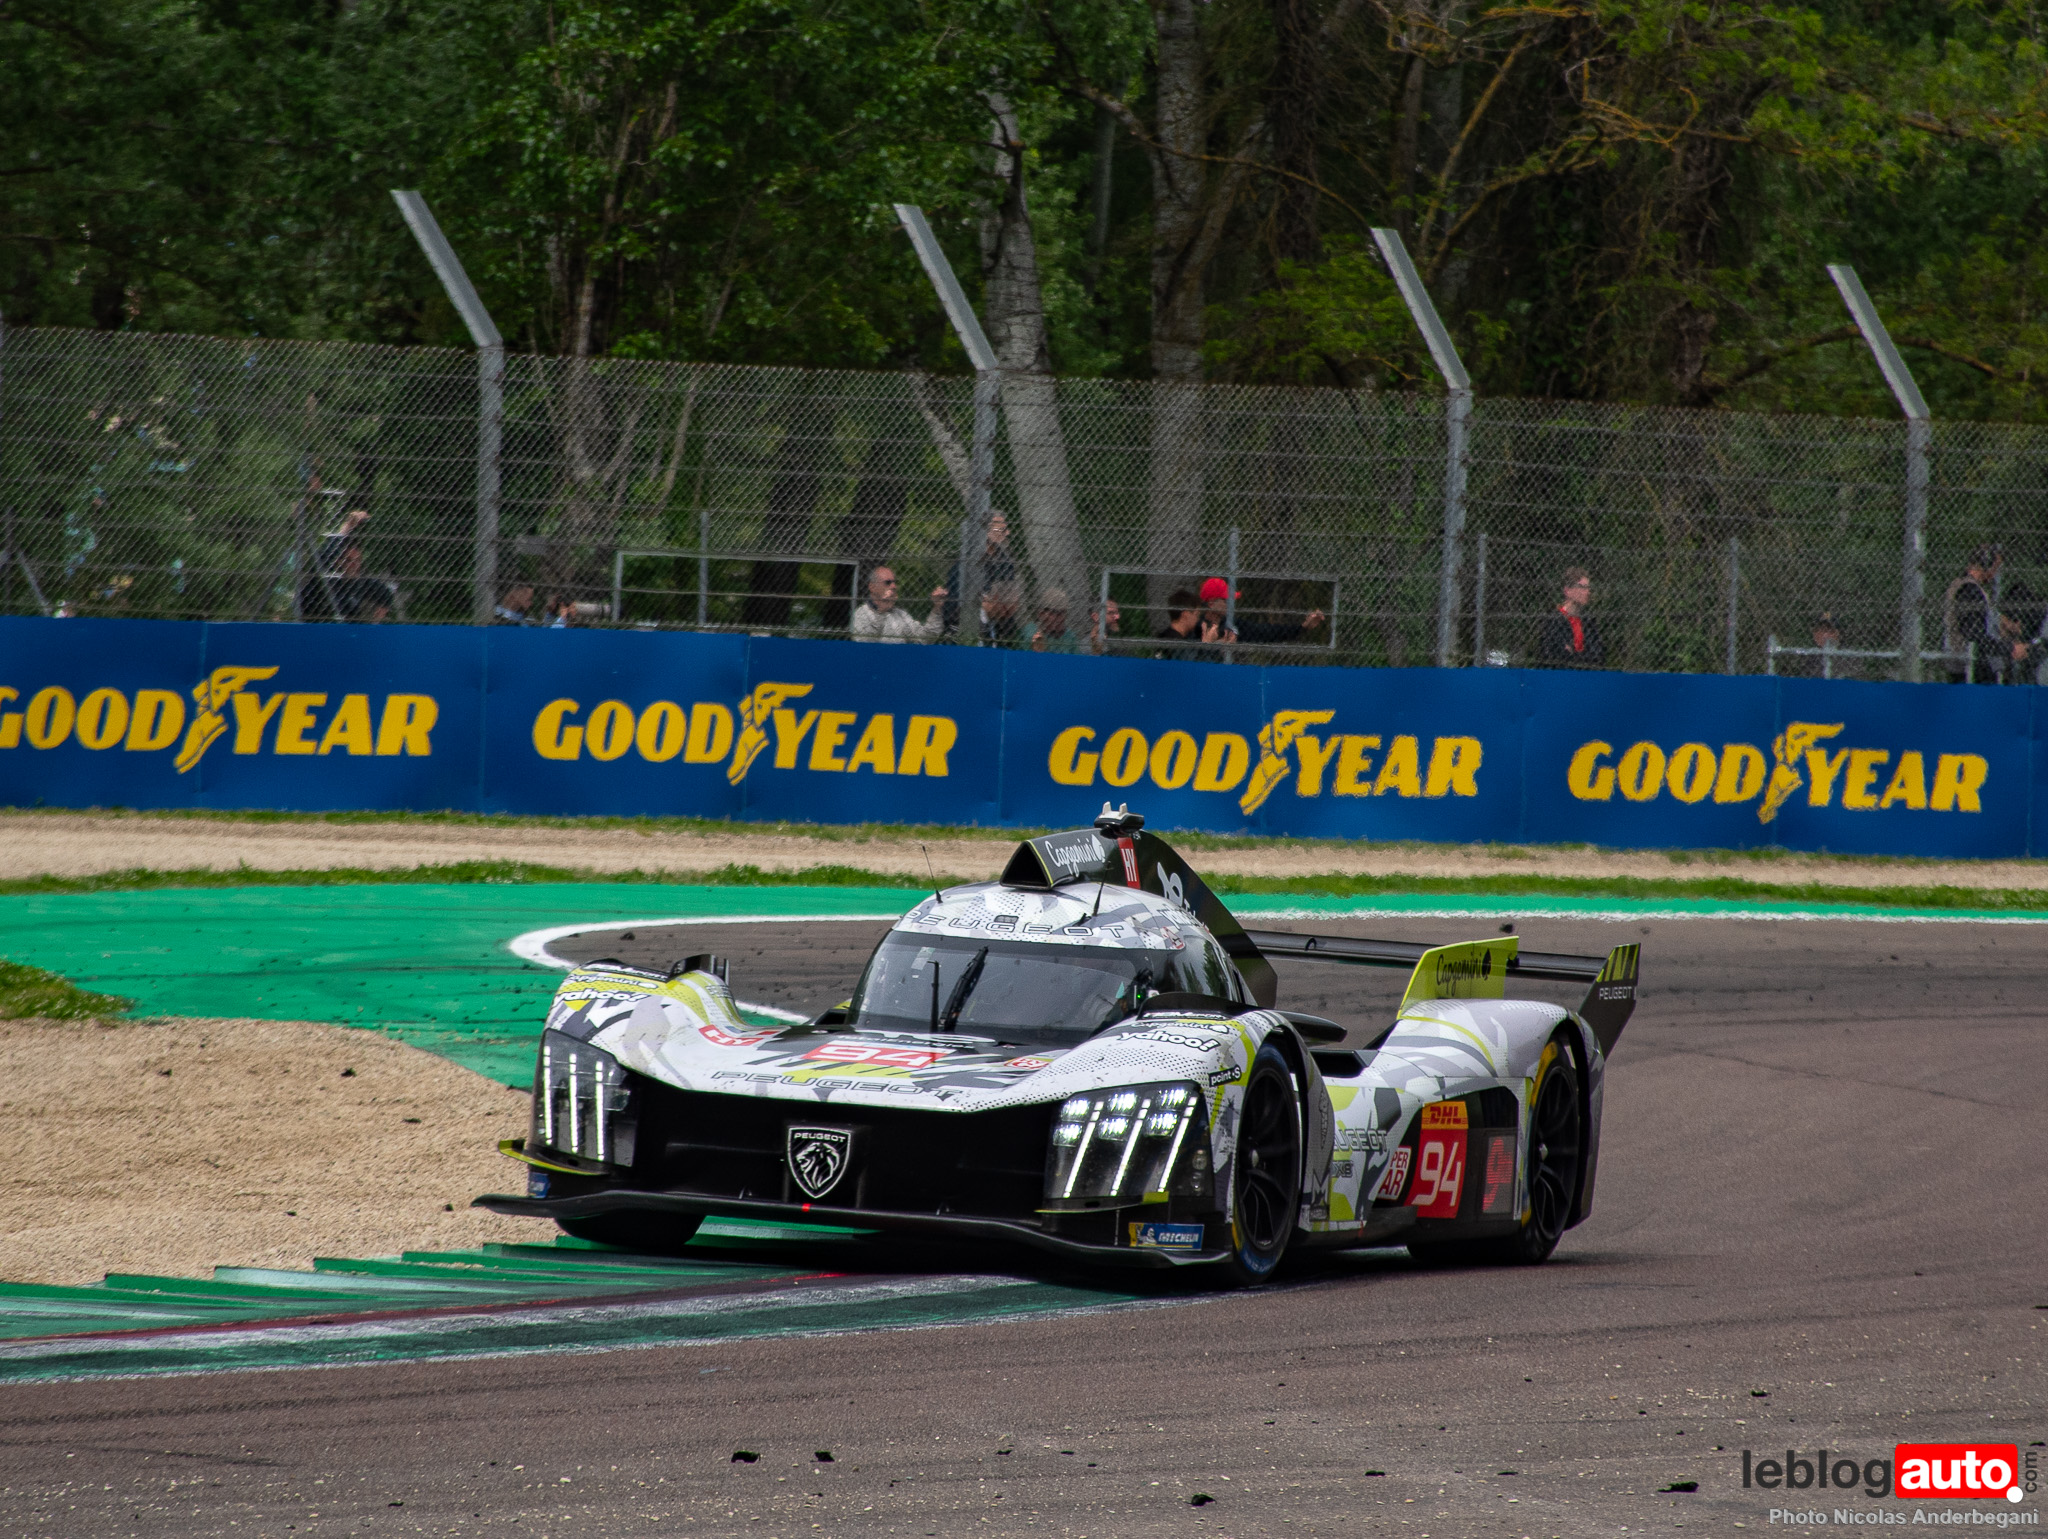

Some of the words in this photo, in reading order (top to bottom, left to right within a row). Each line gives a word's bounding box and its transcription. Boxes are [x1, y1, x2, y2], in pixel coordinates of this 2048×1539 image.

[1045, 838, 1095, 877] Capgemini
[1121, 848, 1137, 882] HY
[907, 910, 1124, 939] PEUGEOT
[1436, 953, 1482, 997] Capgemini
[1600, 986, 1633, 1000] PEUGEOT
[1117, 1030, 1221, 1052] yahoo!
[817, 1046, 933, 1067] 94
[711, 1071, 962, 1098] PEUGEOT
[1429, 1106, 1462, 1124] DHL
[794, 1132, 846, 1142] PEUGEOT
[1390, 1151, 1409, 1168] PER
[1411, 1141, 1462, 1207] 94
